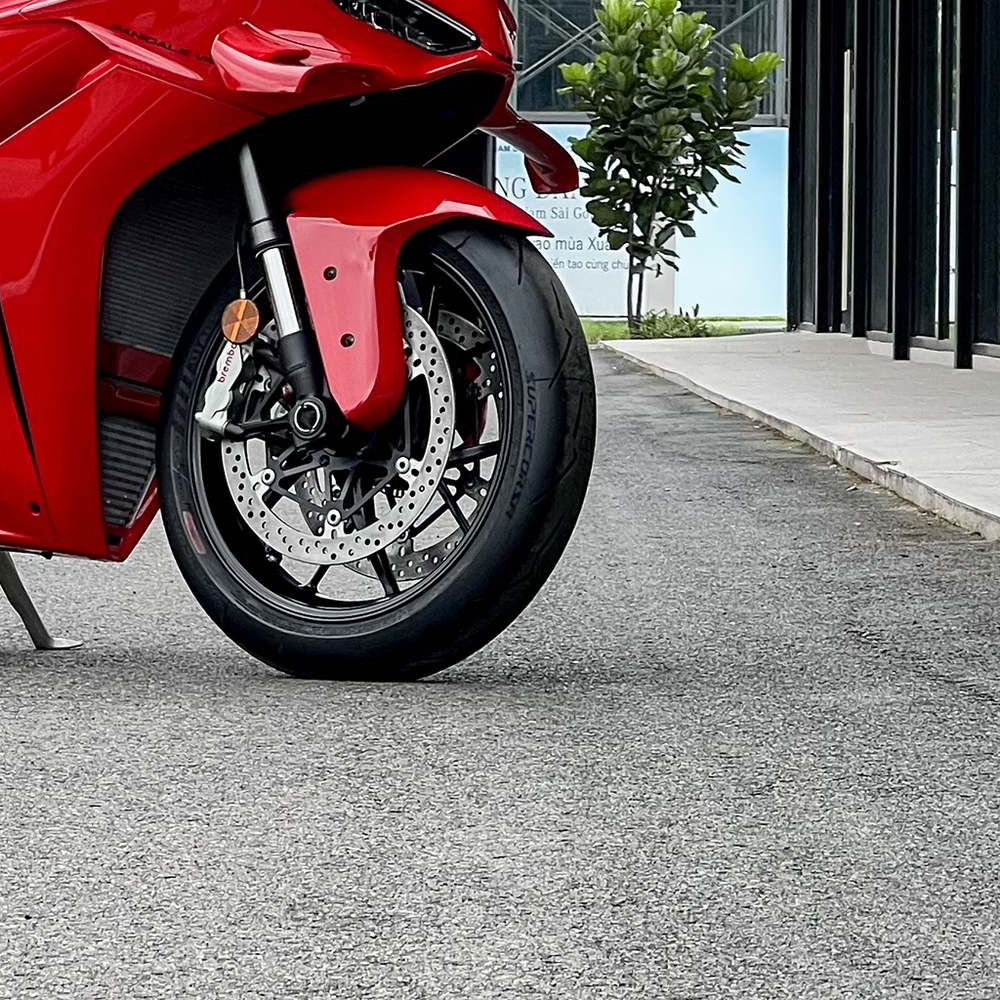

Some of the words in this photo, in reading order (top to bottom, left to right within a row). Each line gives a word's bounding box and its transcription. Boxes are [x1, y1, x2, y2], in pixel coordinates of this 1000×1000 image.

[110, 24, 191, 57] PANIGALE
[550, 206, 569, 219] Sài
[555, 236, 583, 250] mùa
